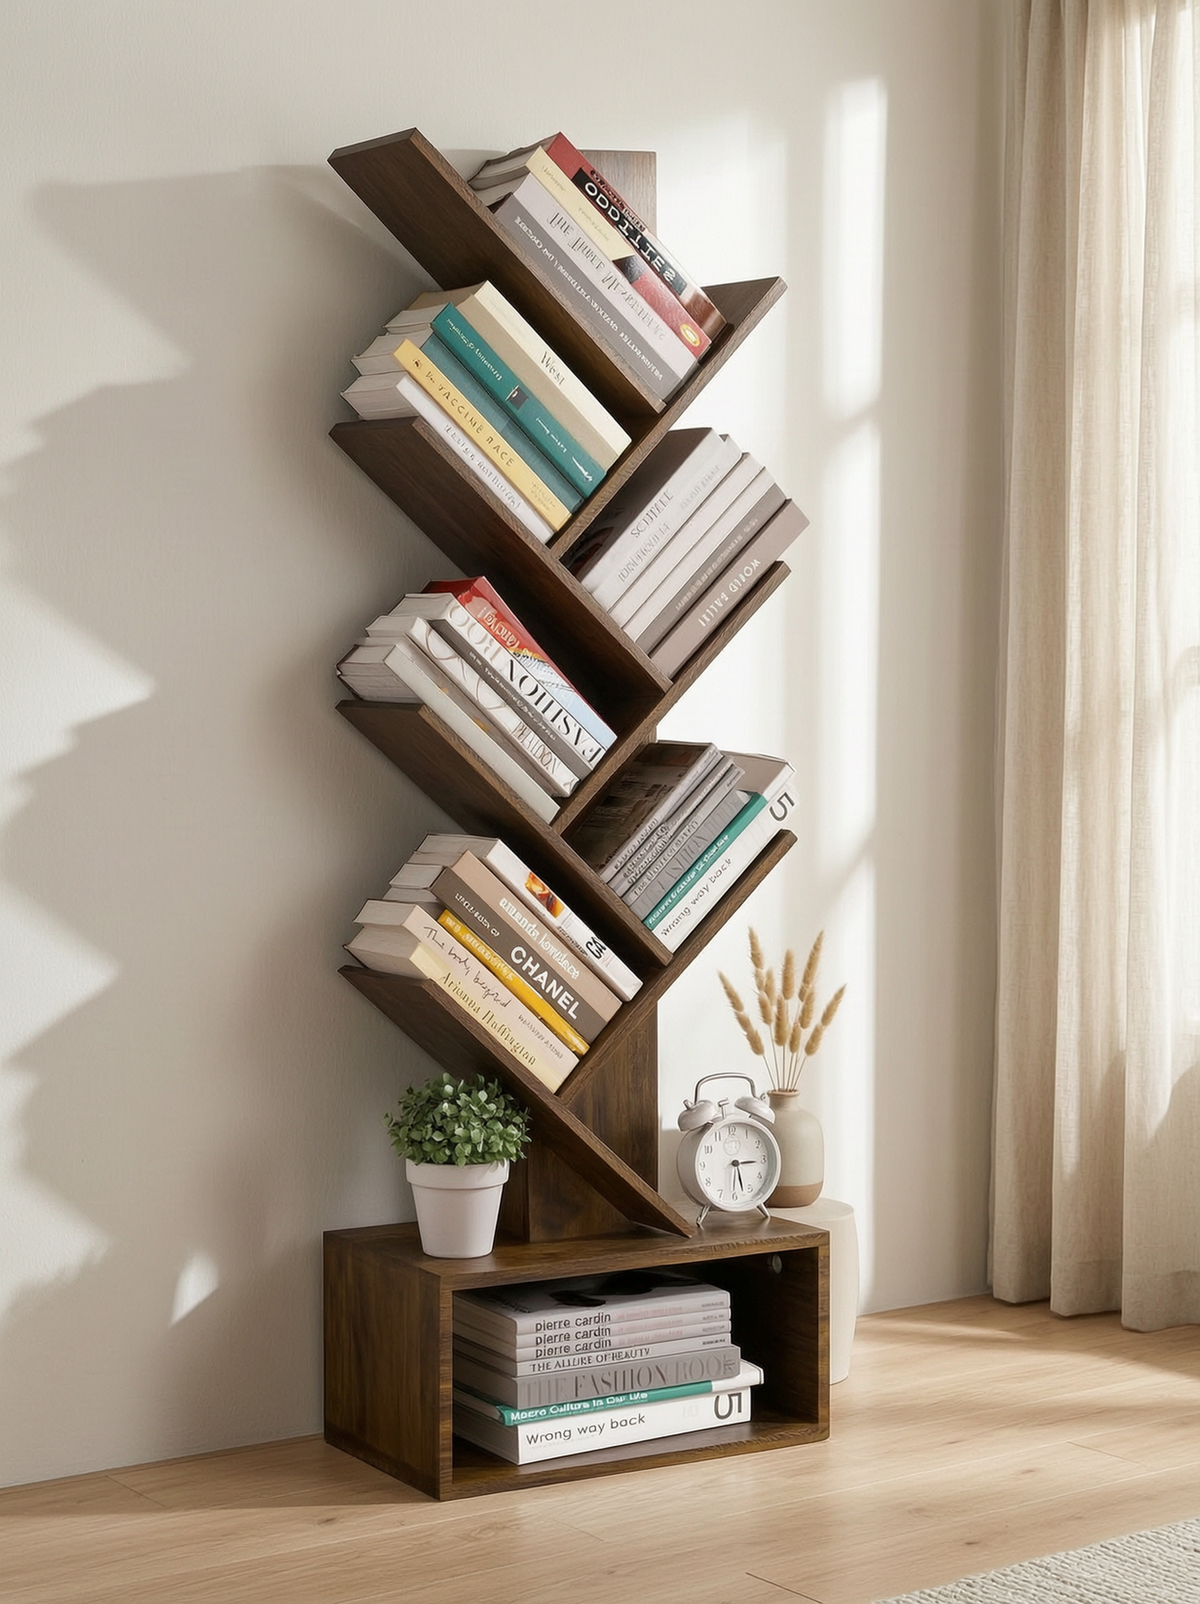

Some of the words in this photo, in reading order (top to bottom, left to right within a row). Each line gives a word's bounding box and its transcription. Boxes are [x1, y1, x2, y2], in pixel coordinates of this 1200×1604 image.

[510, 946, 580, 1020] CHANEL
[534, 1317, 571, 1333] pierre
[575, 1312, 612, 1327] cardin
[534, 1331, 571, 1346] pierre
[575, 1326, 611, 1340] cardin
[575, 1338, 612, 1353] cardin
[574, 1364, 669, 1398] FASHION
[526, 1425, 572, 1446] Wrong
[577, 1422, 605, 1438] way
[610, 1412, 646, 1430] back
